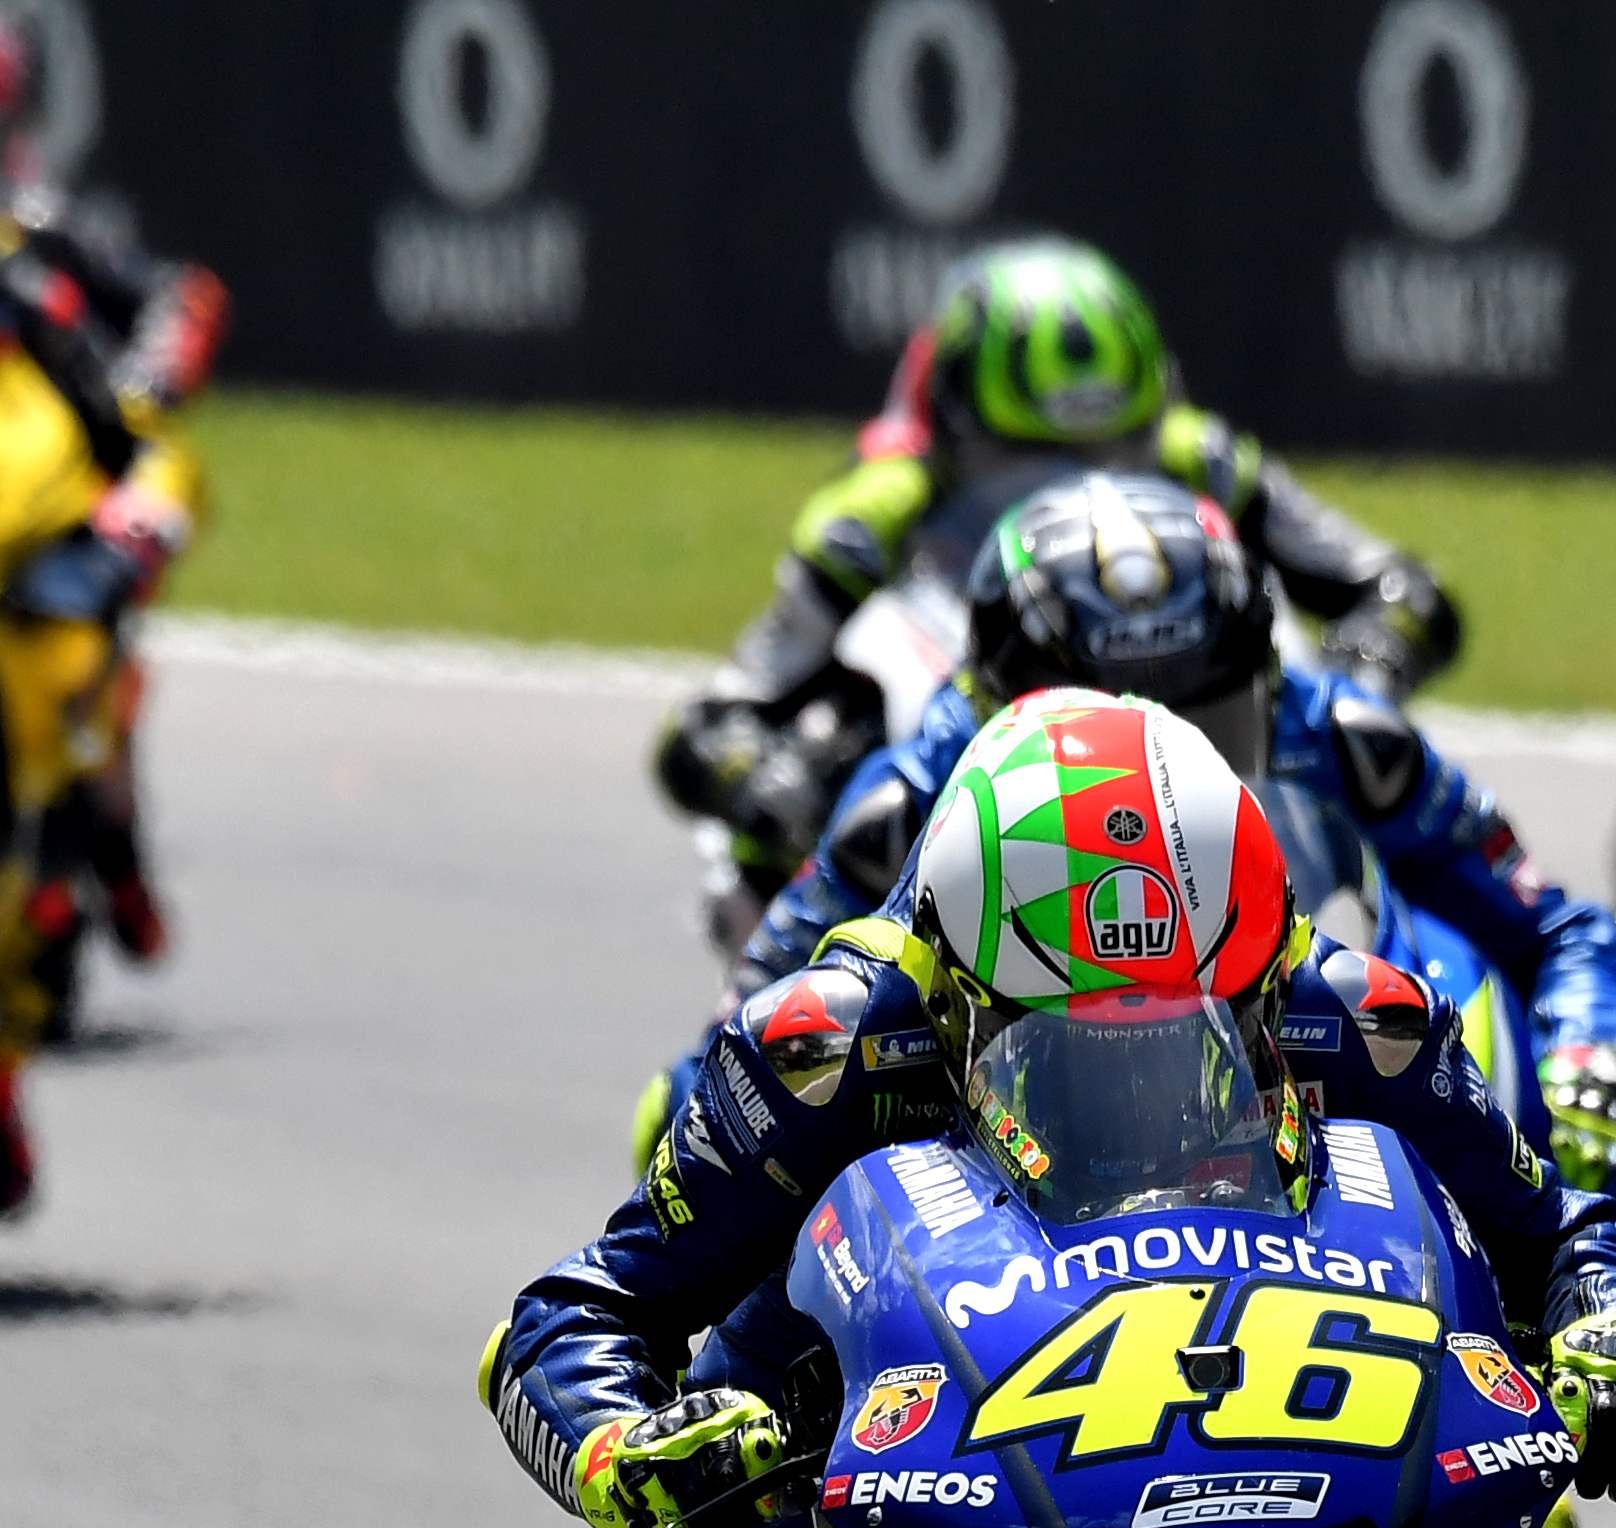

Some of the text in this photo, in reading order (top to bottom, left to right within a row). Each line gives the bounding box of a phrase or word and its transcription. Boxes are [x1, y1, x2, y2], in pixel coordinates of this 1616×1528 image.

[1185, 875, 1200, 911] VIVA
[1100, 921, 1169, 953] agv
[718, 1040, 777, 1139] YAMALUBE
[887, 1143, 984, 1240] YAMAHA
[1053, 1225, 1393, 1293] movistar
[876, 1369, 941, 1387] ABARTH
[968, 1283, 1443, 1456] 46
[495, 1363, 581, 1518] YAMAHA
[1467, 1431, 1580, 1476] ENEOS
[850, 1471, 998, 1507] ENEOS
[1170, 1478, 1301, 1498] BLUE
[1162, 1502, 1292, 1522] CORE
